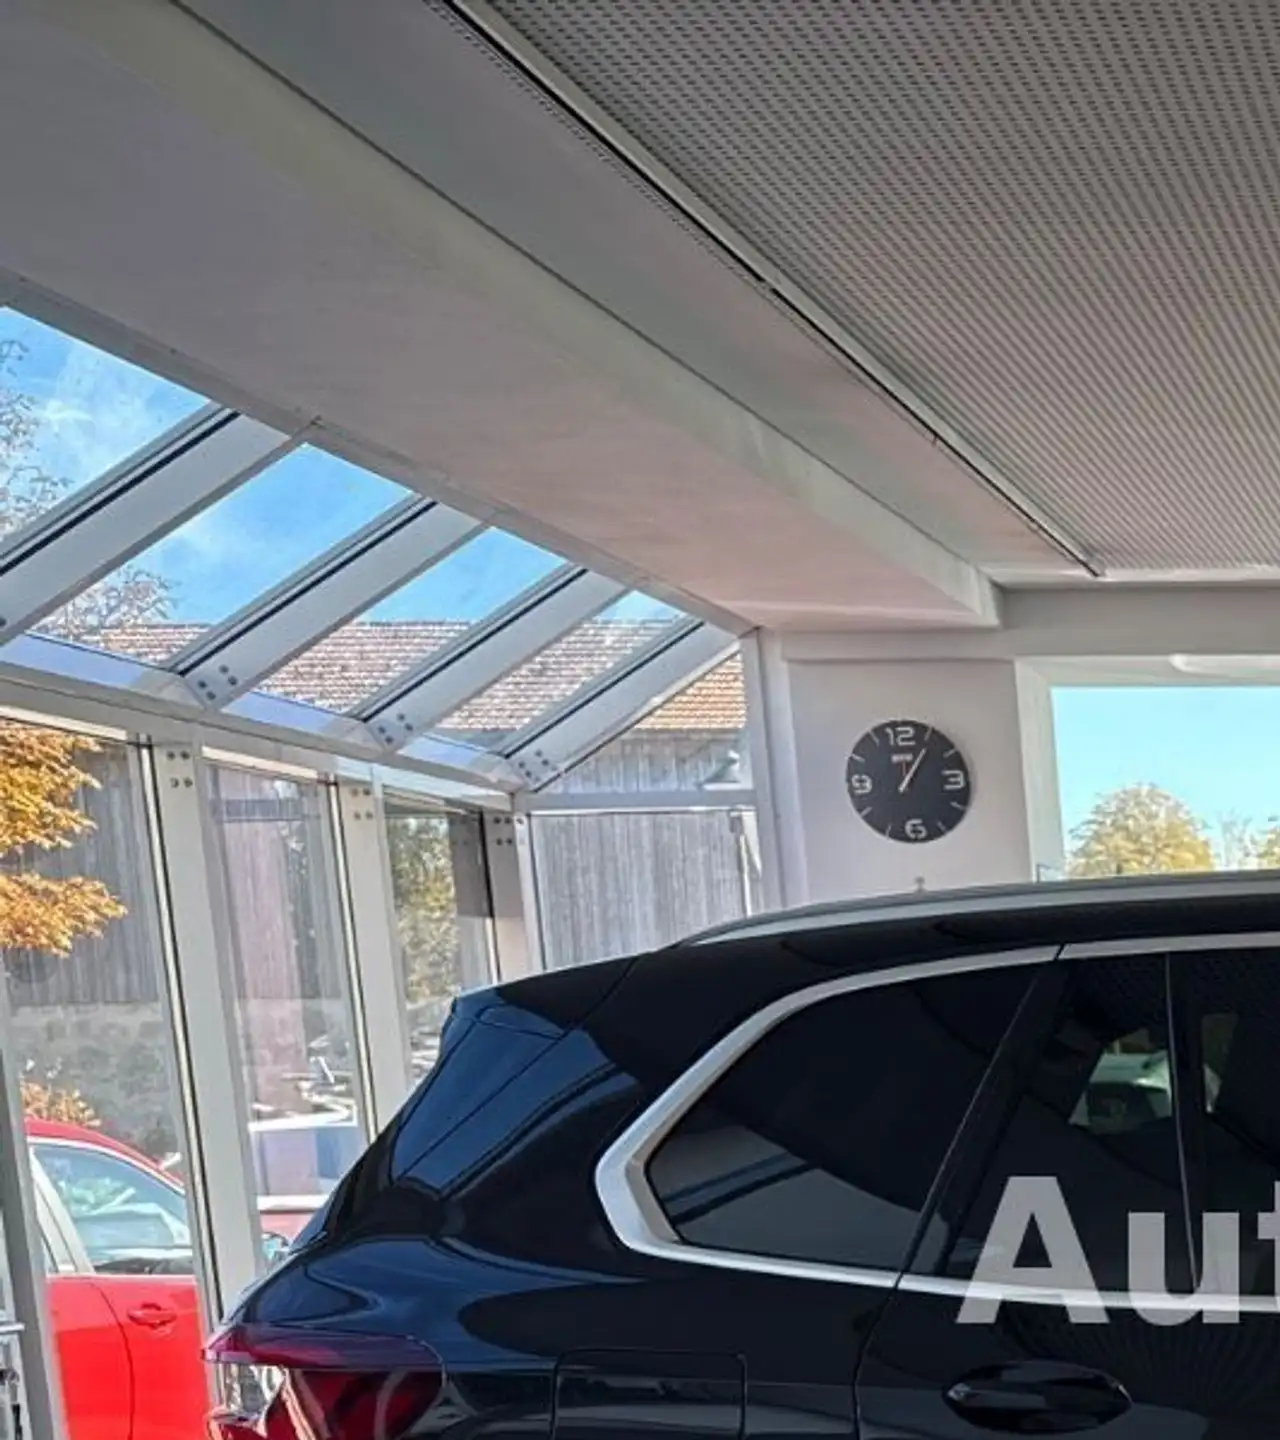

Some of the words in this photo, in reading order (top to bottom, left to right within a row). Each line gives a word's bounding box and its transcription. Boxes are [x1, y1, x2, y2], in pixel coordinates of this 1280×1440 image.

[884, 726, 916, 746] 12
[851, 774, 872, 794] 9
[942, 770, 965, 790] 3
[905, 819, 928, 839] 6
